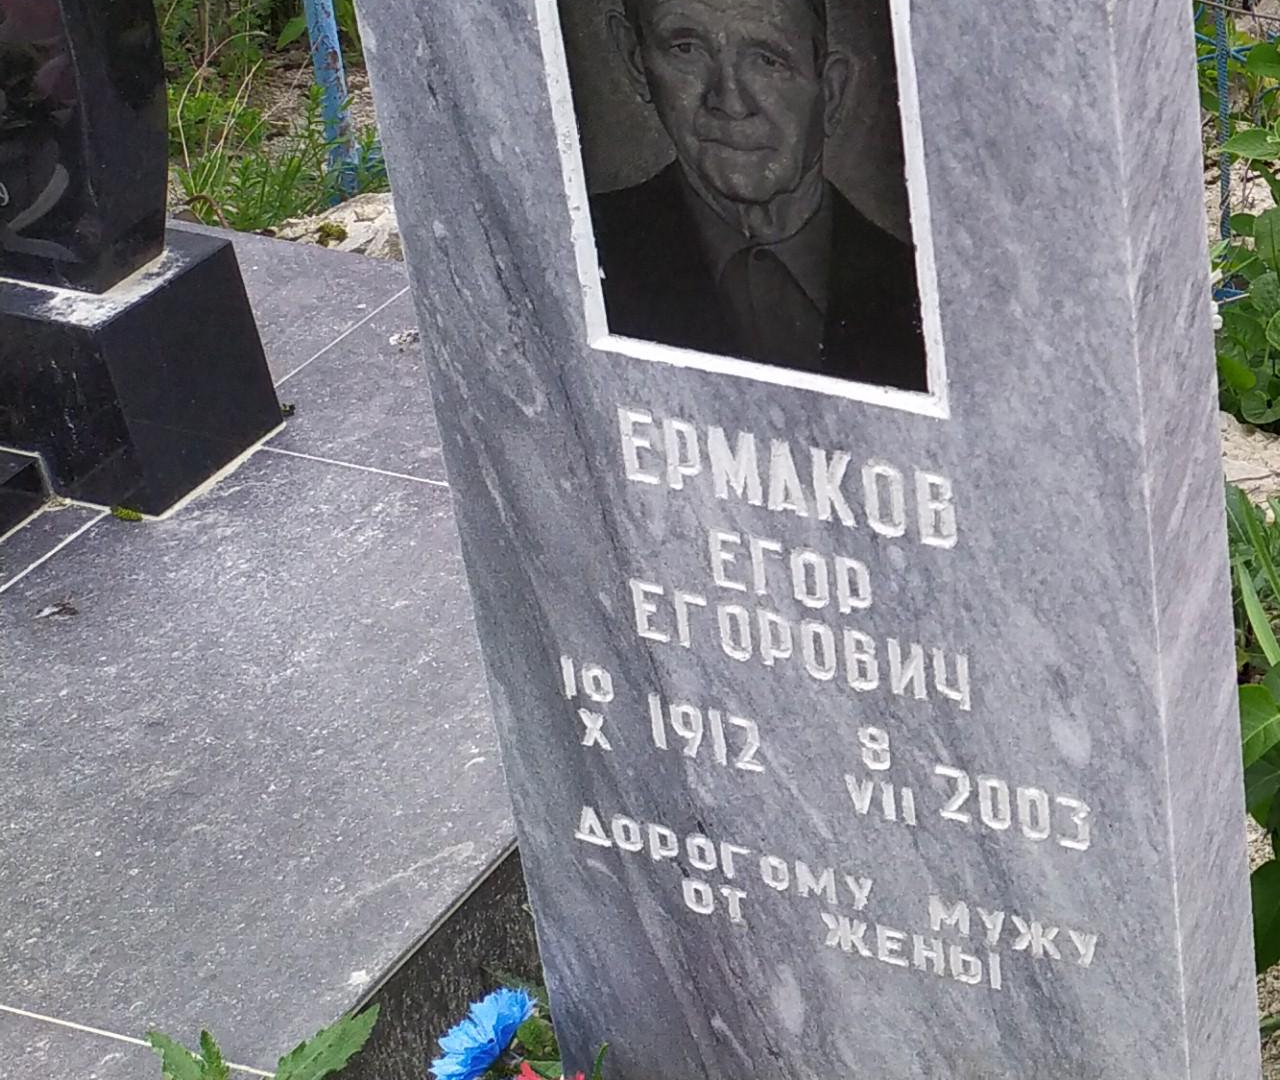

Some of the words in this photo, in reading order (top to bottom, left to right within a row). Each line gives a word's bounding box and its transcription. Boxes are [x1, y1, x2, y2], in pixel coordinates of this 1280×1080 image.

[617, 404, 958, 549] ЕРМАКОВ
[708, 526, 873, 614] ЕГОР
[559, 654, 614, 704] 10
[629, 578, 972, 711] ЕГОРОВИЧ
[647, 692, 766, 773] 1912
[857, 724, 892, 771] 8
[844, 772, 917, 826] VII
[933, 764, 1093, 851] 2003
[573, 804, 873, 910] ДОРОГОМУ
[927, 893, 1098, 967] МУЖУ
[681, 877, 747, 923] ОТ
[821, 910, 1002, 990] ЖЕНЫ
